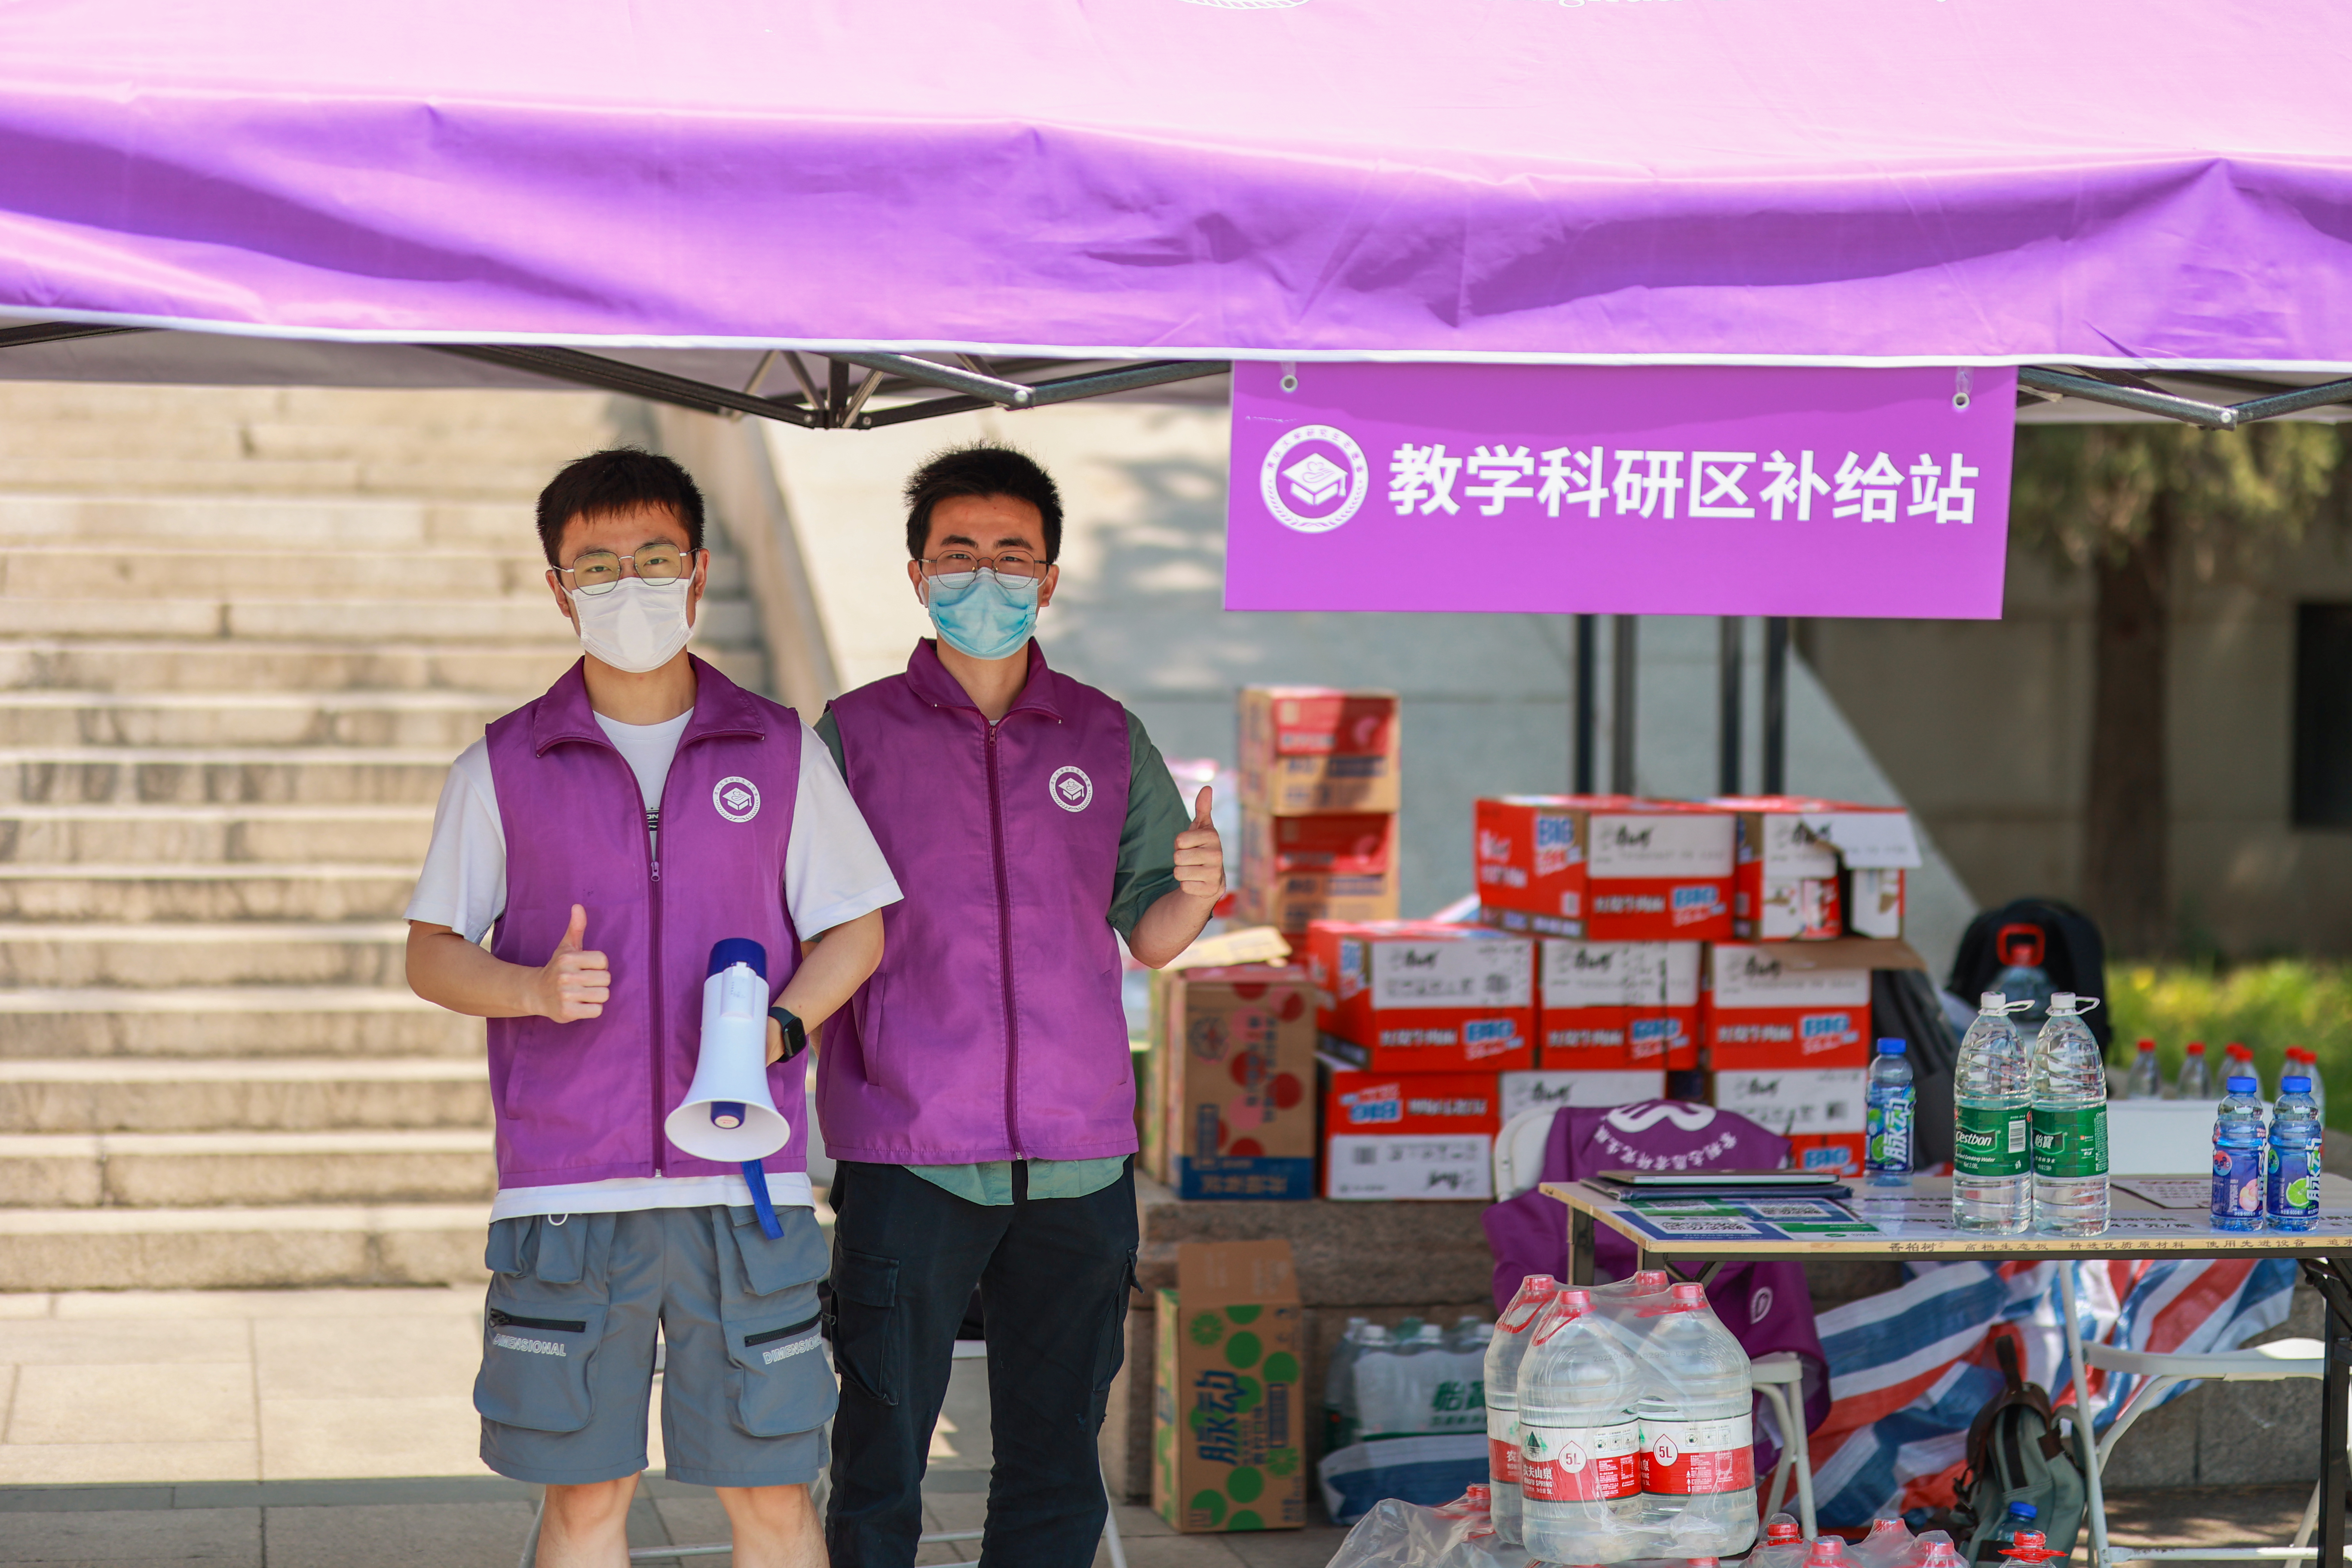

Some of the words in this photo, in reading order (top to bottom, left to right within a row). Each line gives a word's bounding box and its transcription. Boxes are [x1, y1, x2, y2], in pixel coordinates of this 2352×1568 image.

[1388, 443, 1979, 524] 教学科研区补给站
[1883, 1098, 1911, 1163] 脉动
[2205, 1239, 2306, 1248] 使用先进设备
[493, 1333, 567, 1357] DIMENSIONAL
[1194, 1369, 1249, 1465] 脉动
[1565, 1453, 1580, 1465] 5L
[1660, 1446, 1672, 1458] 5L
[1523, 1464, 1553, 1480] 农夫山泉
